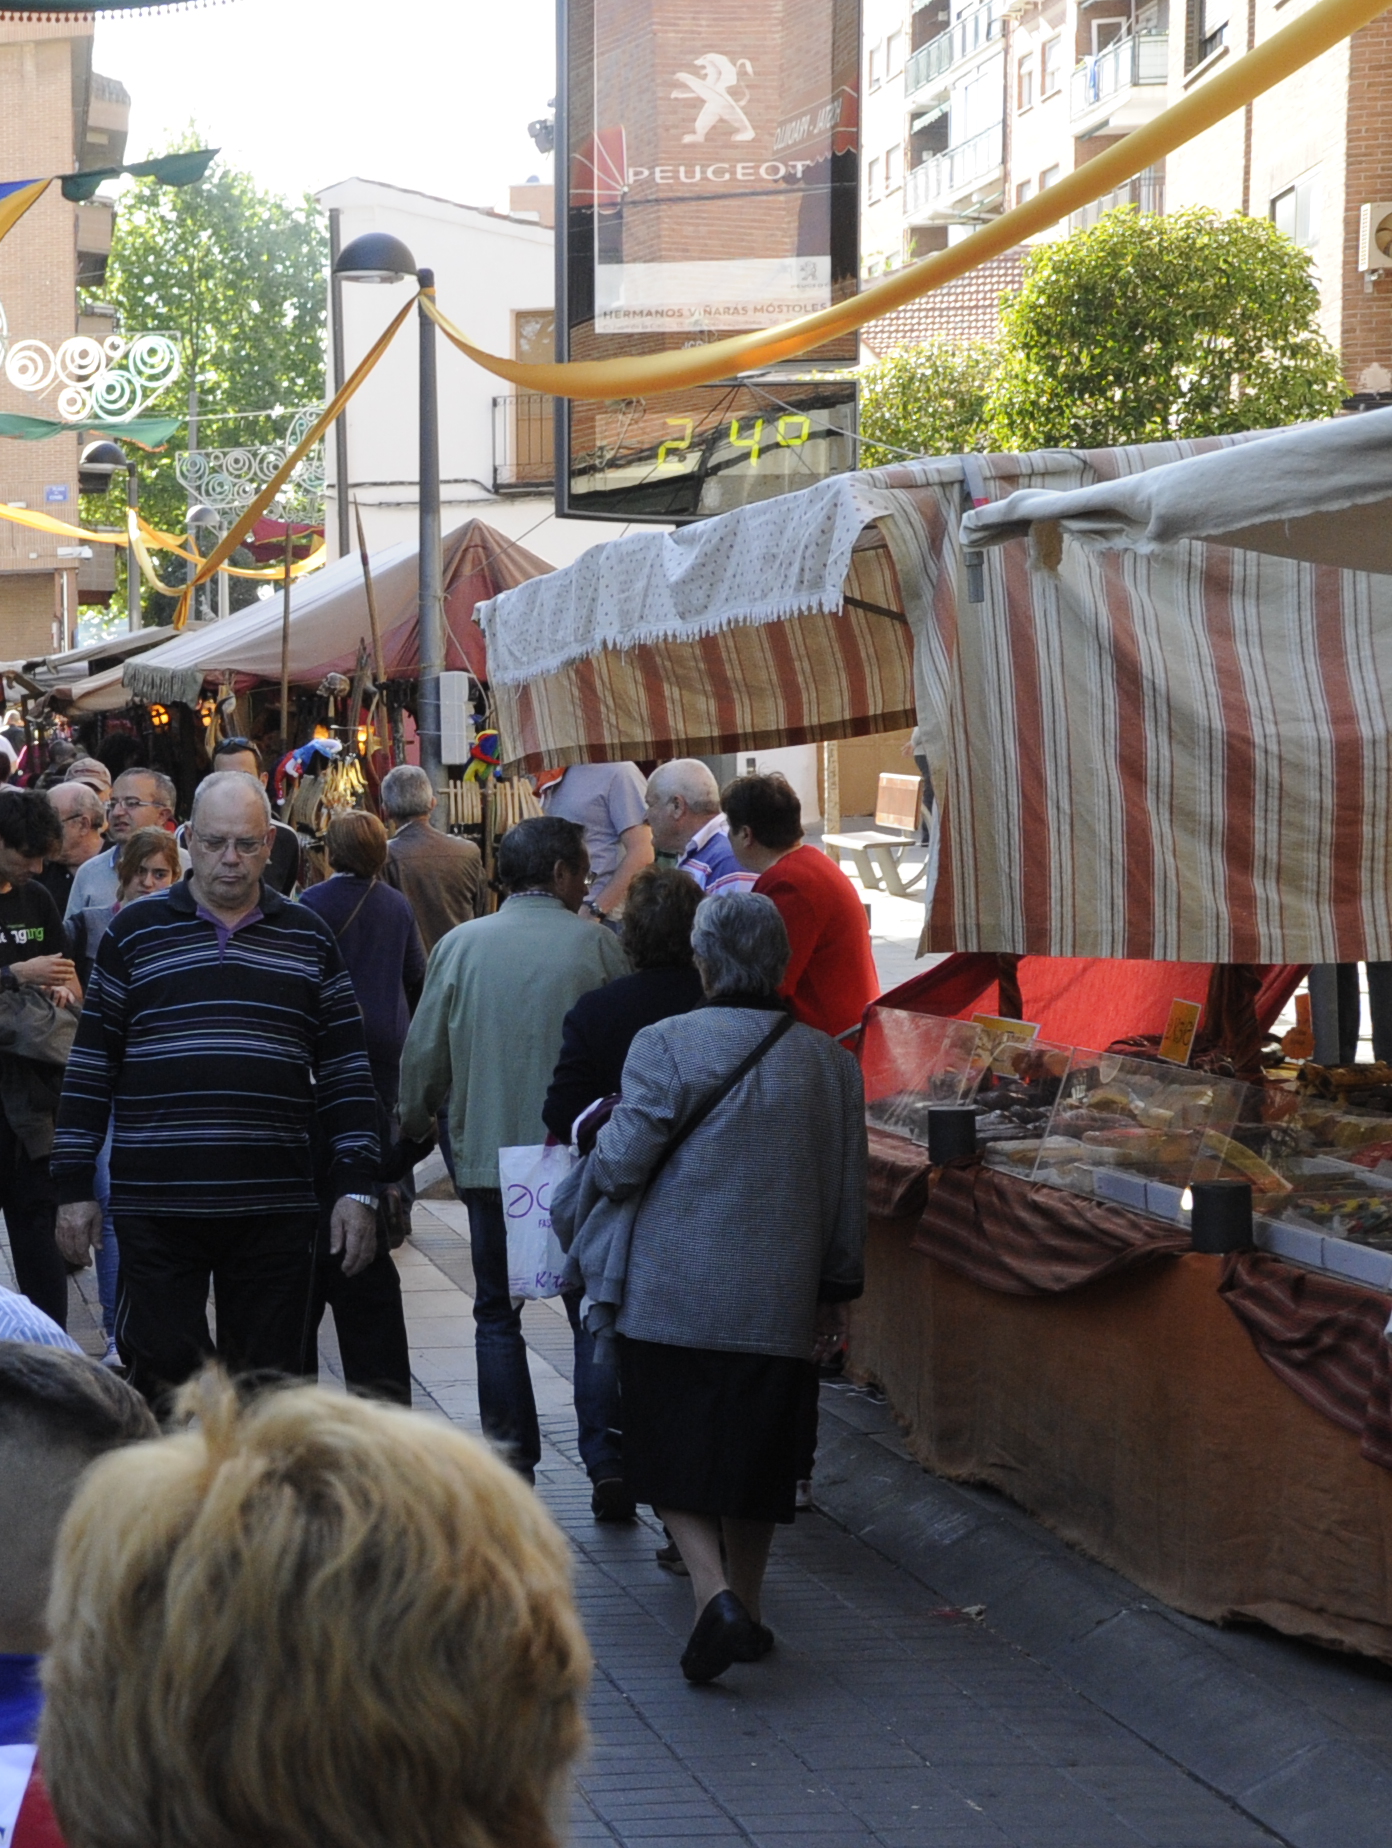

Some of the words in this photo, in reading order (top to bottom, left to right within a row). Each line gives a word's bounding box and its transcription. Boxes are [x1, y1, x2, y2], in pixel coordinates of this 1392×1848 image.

[628, 160, 810, 184] PEUGEOT
[603, 308, 684, 320] HERMANOS
[753, 301, 827, 315] MÓSTOLES
